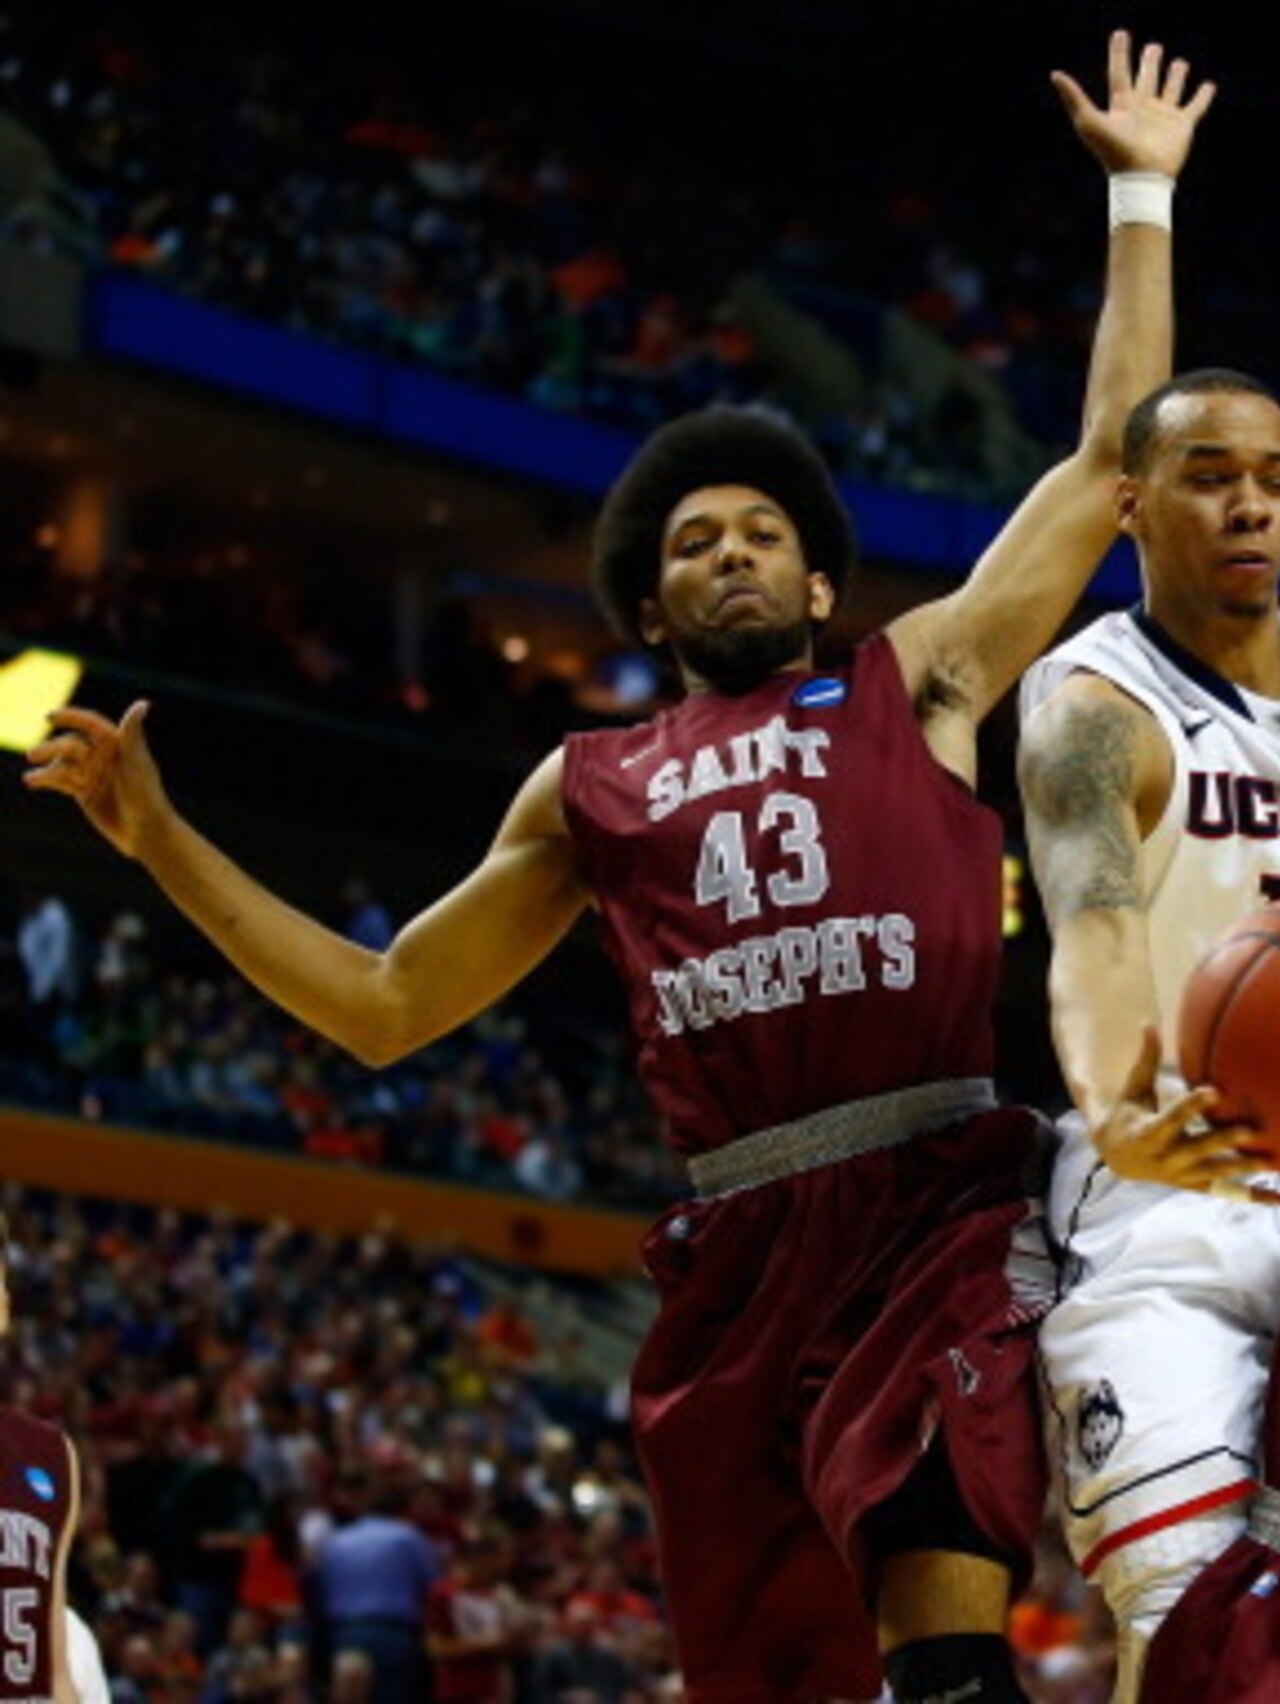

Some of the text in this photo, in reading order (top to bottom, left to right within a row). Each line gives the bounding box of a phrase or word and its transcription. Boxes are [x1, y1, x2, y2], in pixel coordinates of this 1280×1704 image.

[646, 714, 831, 822] SAINT
[695, 790, 829, 923] 43
[651, 913, 916, 1036] JOSEPH'S
